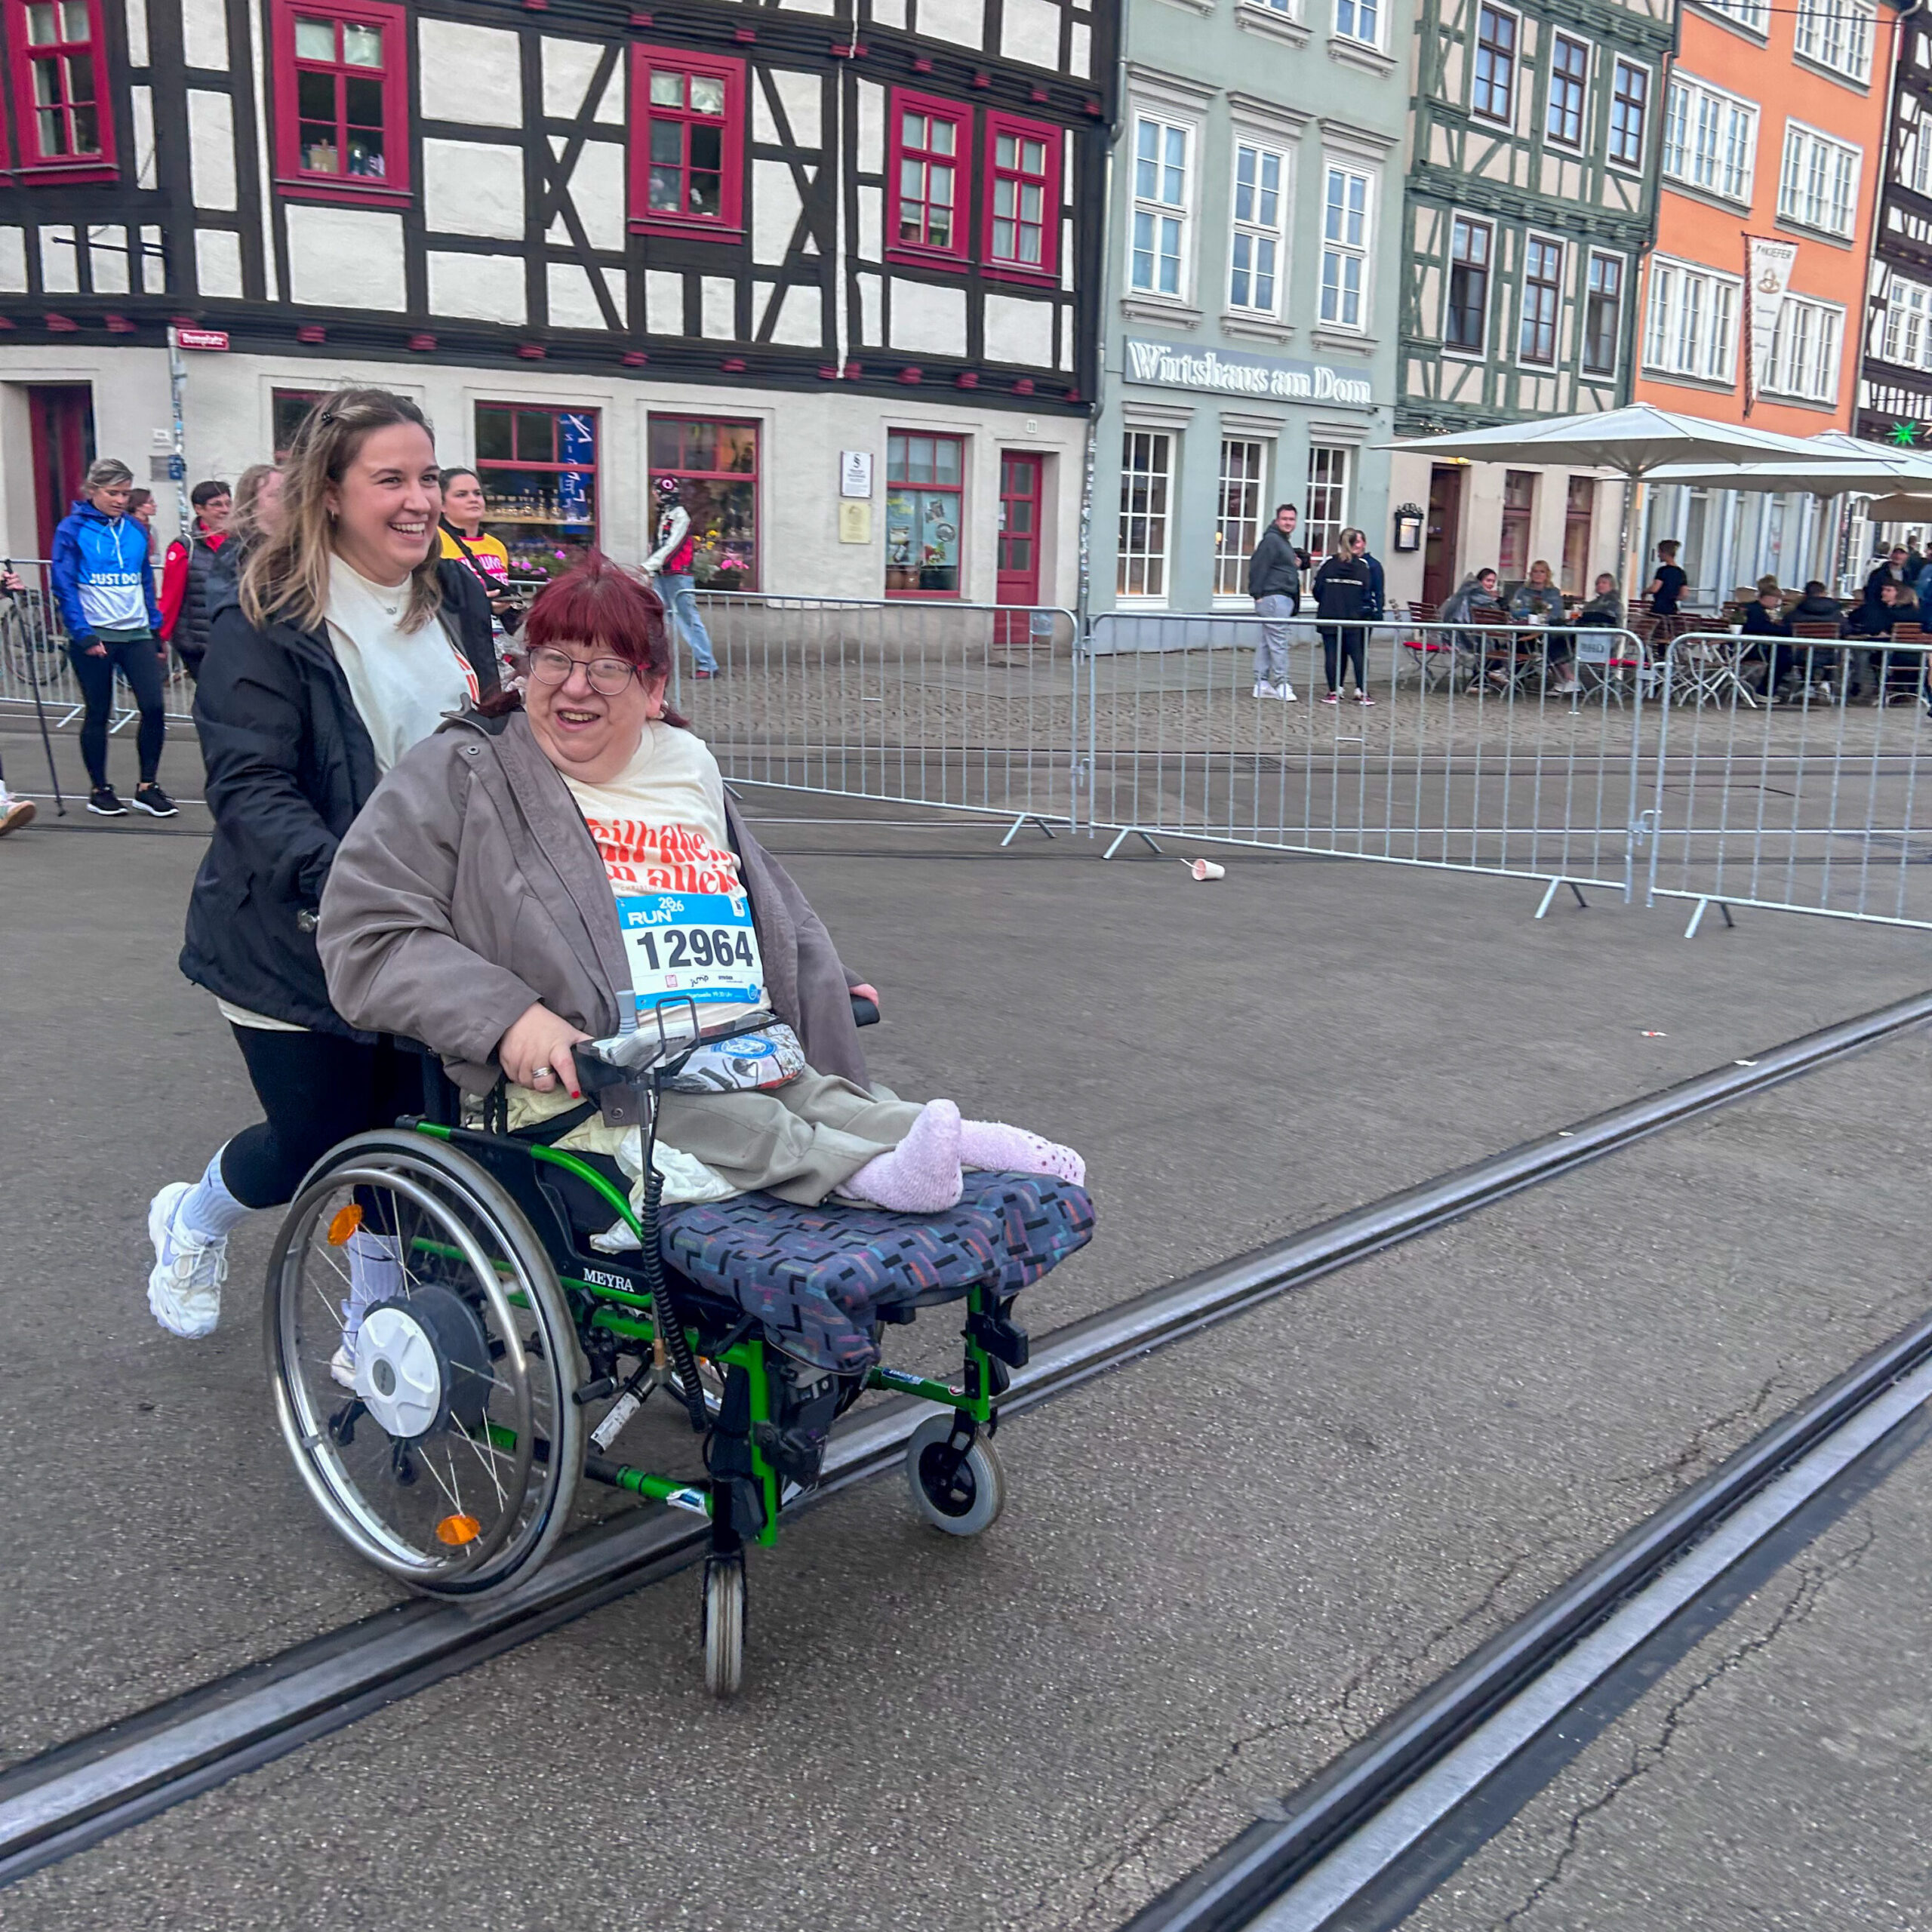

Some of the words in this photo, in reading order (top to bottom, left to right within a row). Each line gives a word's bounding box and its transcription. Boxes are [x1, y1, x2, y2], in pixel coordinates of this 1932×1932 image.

[1128, 342, 1269, 392] Wirtshaus
[1271, 369, 1312, 397] am
[1314, 367, 1371, 403] Dom
[89, 573, 119, 585] JUST
[122, 572, 137, 585] DO
[627, 909, 673, 926] RUN
[636, 928, 754, 971] 12964
[690, 974, 709, 988] jump
[583, 1267, 635, 1293] MEYRA
